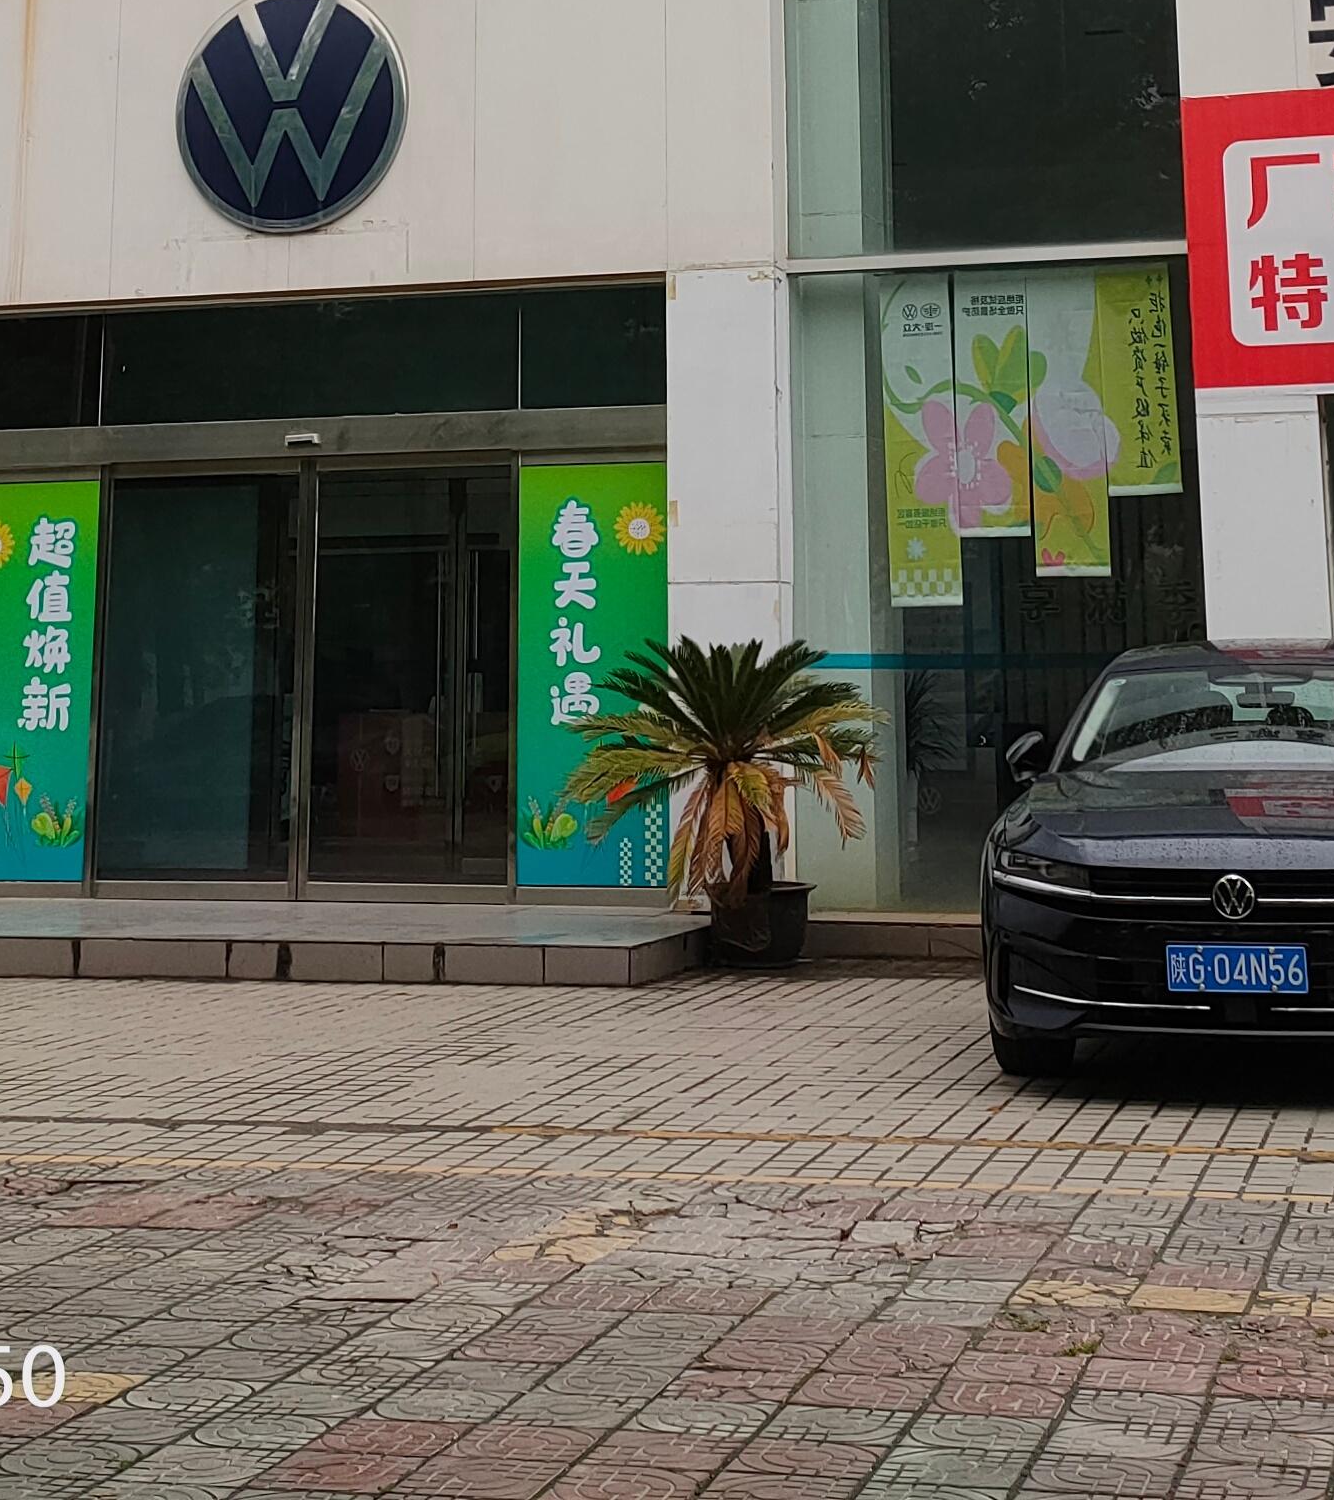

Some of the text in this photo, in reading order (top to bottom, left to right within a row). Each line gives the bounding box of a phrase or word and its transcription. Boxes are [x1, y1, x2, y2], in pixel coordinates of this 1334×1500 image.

[17, 517, 77, 732] 超值焕新
[550, 499, 602, 726] 春天礼遇
